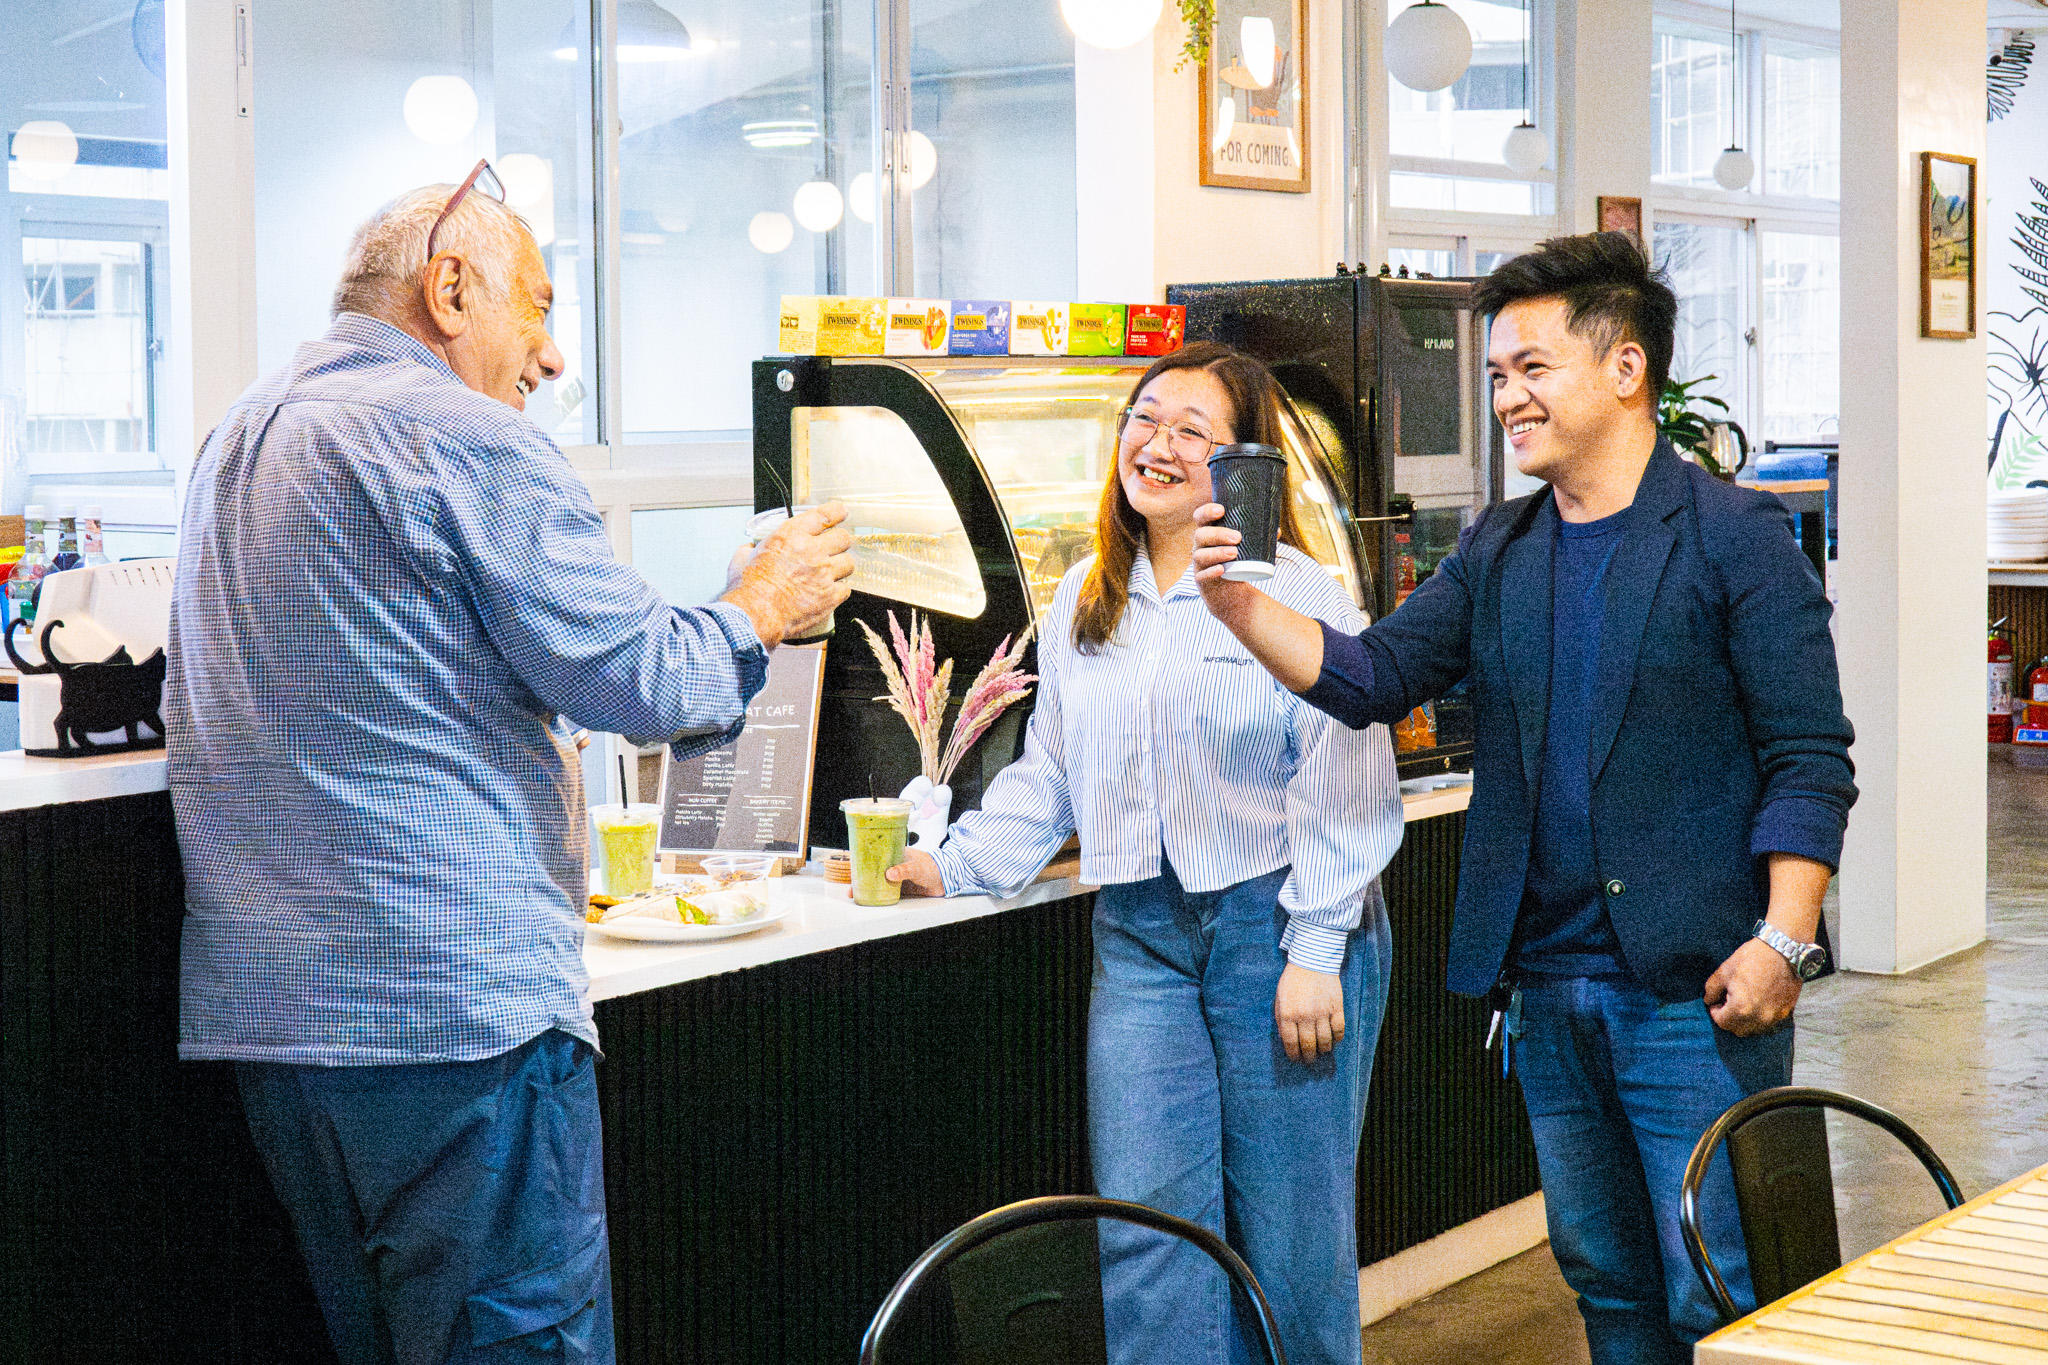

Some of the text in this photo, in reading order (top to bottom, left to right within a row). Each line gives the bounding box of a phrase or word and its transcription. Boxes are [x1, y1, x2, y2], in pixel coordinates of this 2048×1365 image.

[1247, 142, 1292, 167] COMING.
[827, 316, 857, 326] TWININGS
[893, 317, 923, 326] TWININGS
[957, 317, 984, 326] TWININGS
[1019, 318, 1046, 326] TWININGS
[1075, 319, 1102, 328] TWININGS
[746, 704, 795, 717] AT CAFE
